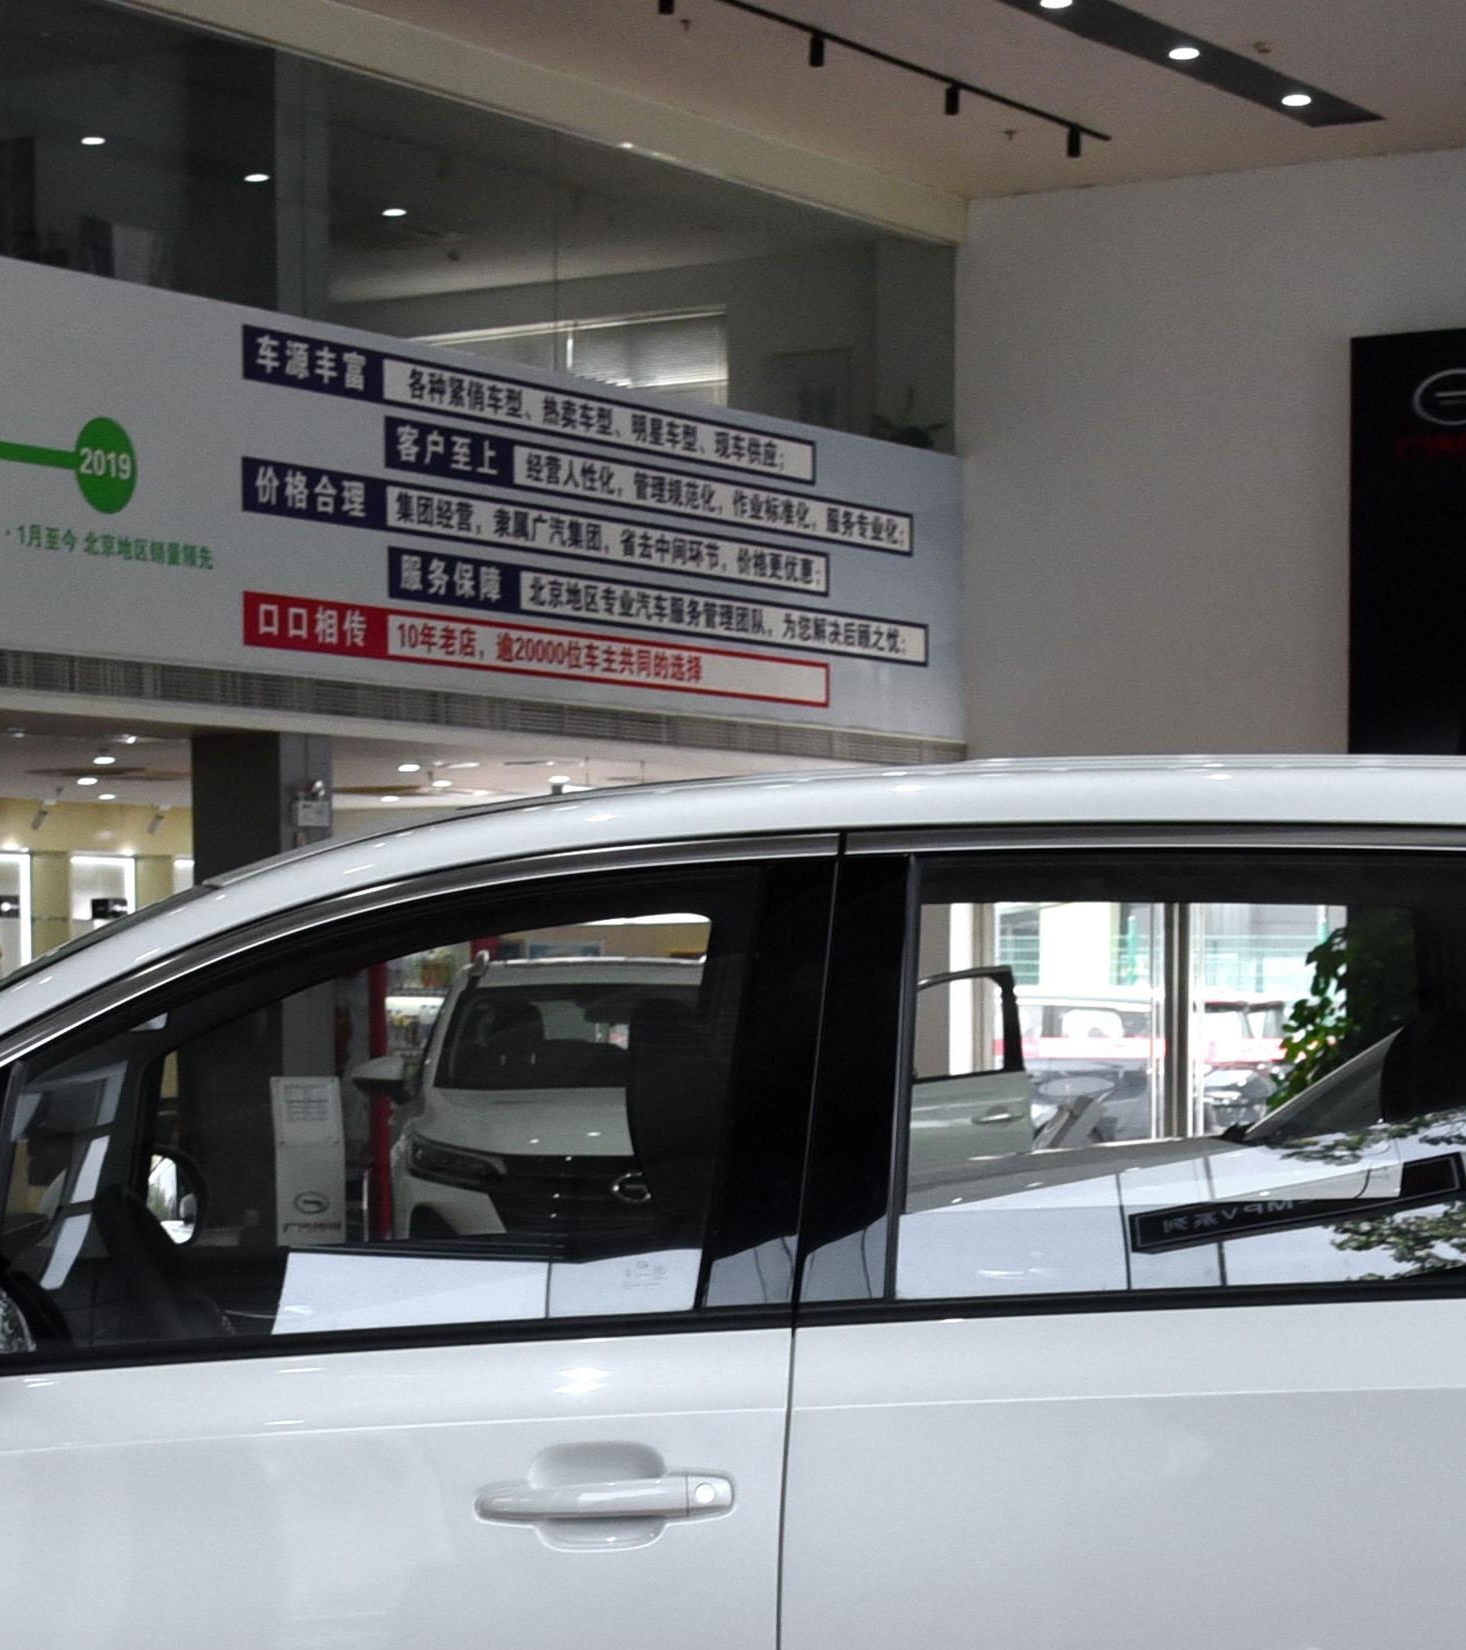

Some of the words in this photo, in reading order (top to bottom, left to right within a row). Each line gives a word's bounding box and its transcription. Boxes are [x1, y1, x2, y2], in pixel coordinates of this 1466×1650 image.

[255, 334, 367, 392] 车源丰富
[79, 447, 132, 480] 2019
[396, 425, 499, 476] 客户至上
[254, 466, 367, 518] 价格合理
[17, 523, 78, 553] 1月至今
[401, 555, 503, 603] 服务保障
[258, 604, 368, 648] 口口相传
